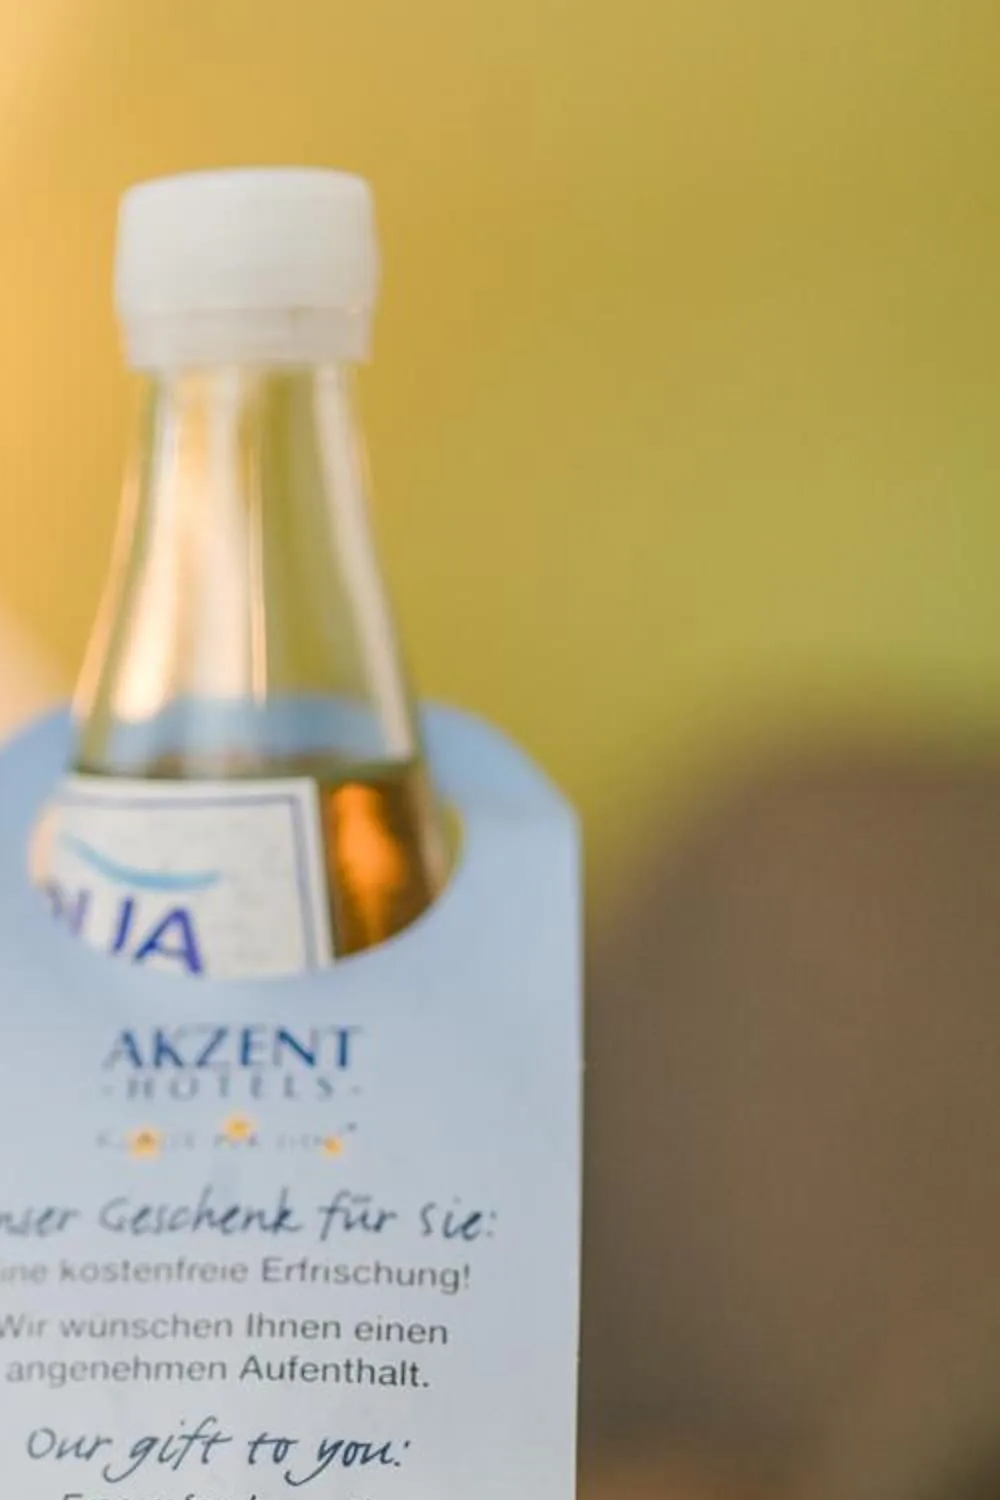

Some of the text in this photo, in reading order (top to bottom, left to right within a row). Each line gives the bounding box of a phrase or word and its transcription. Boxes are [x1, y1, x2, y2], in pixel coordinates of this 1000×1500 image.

[101, 1024, 363, 1068] AKZENT
[100, 1188, 302, 1235] Geschenk
[319, 1191, 397, 1241] für
[59, 1256, 249, 1284] kostenfreie
[262, 1256, 470, 1295] Erfrischung!
[60, 1313, 233, 1339] wünschen
[247, 1313, 341, 1339] Ihnen
[354, 1322, 447, 1344] einen
[6, 1355, 429, 1388] angenehmen Aufenthalt.
[27, 1416, 410, 1487] Our gift to you:
